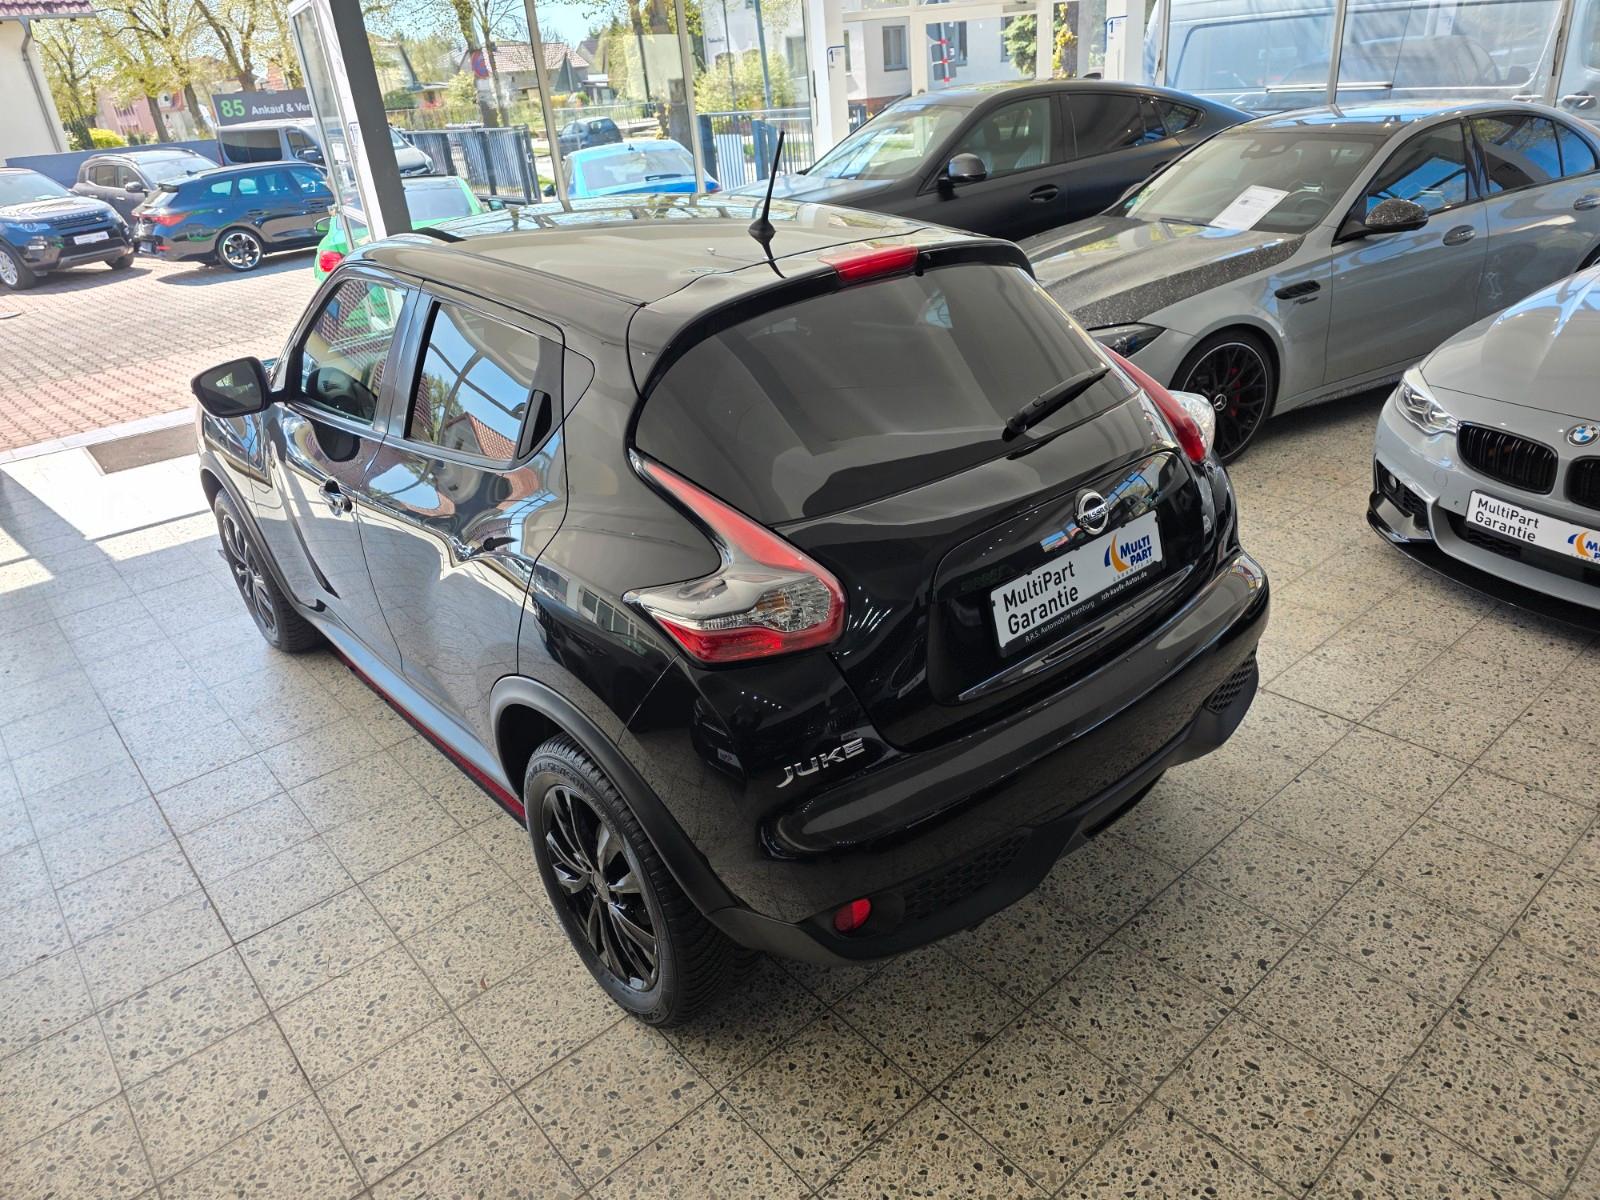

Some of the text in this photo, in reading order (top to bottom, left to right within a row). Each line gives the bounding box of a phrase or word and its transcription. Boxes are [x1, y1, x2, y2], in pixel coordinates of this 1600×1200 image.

[220, 99, 246, 118] 85
[251, 102, 285, 115] Ankauf
[286, 102, 295, 113] &
[1475, 511, 1536, 542] Garantie
[1477, 498, 1539, 529] MultiPart
[1120, 534, 1151, 559] MULTI
[1130, 546, 1152, 566] PART
[1003, 561, 1075, 612] MultiPart
[1007, 586, 1079, 635] Garantie
[776, 737, 865, 788] JUKE
